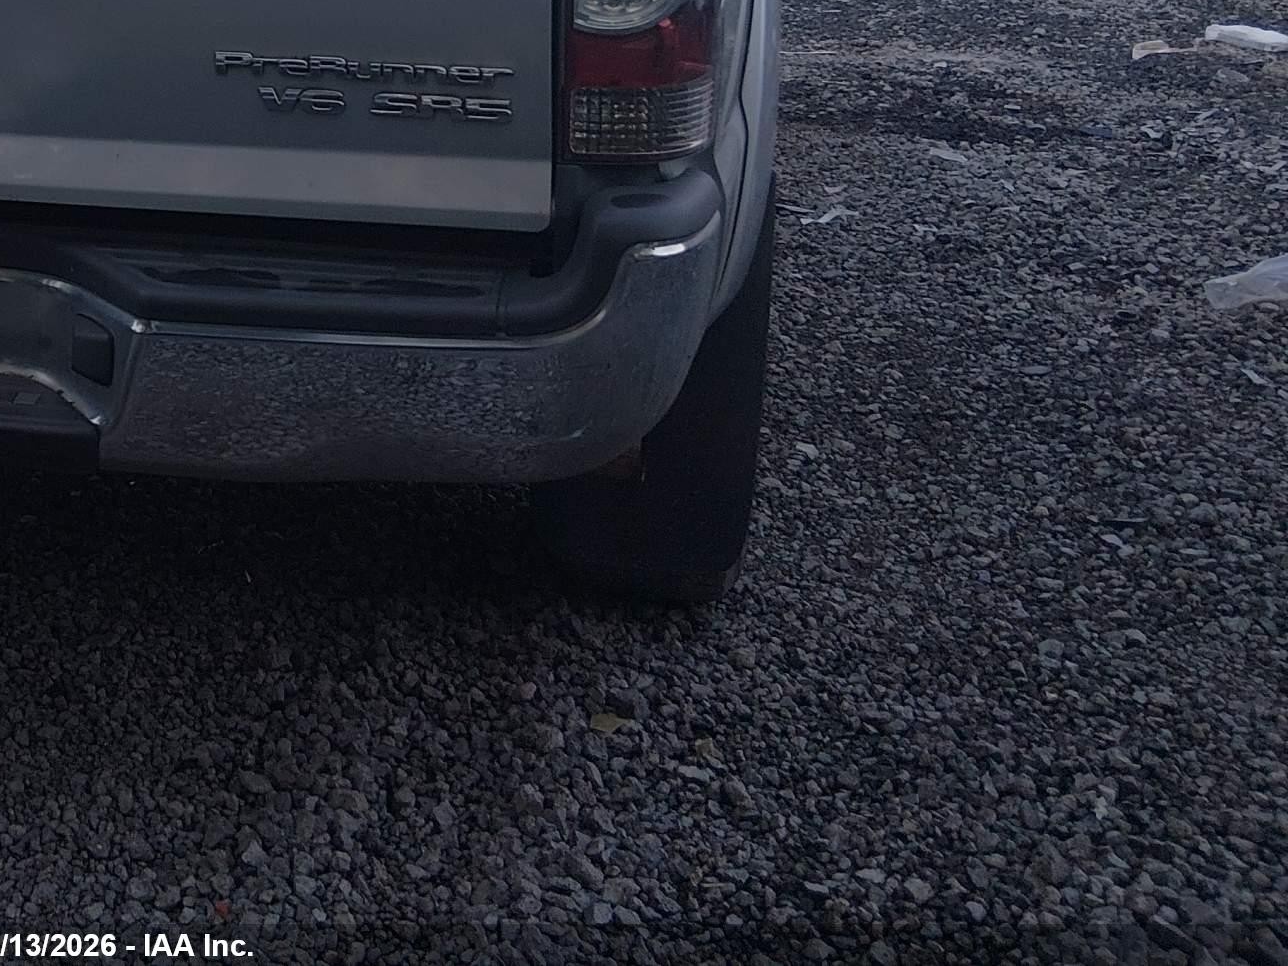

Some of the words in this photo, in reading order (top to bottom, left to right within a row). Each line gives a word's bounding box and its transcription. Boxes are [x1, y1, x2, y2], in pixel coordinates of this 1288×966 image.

[215, 50, 514, 85] PreRunner
[258, 87, 346, 115] V6
[370, 91, 514, 122] SR5
